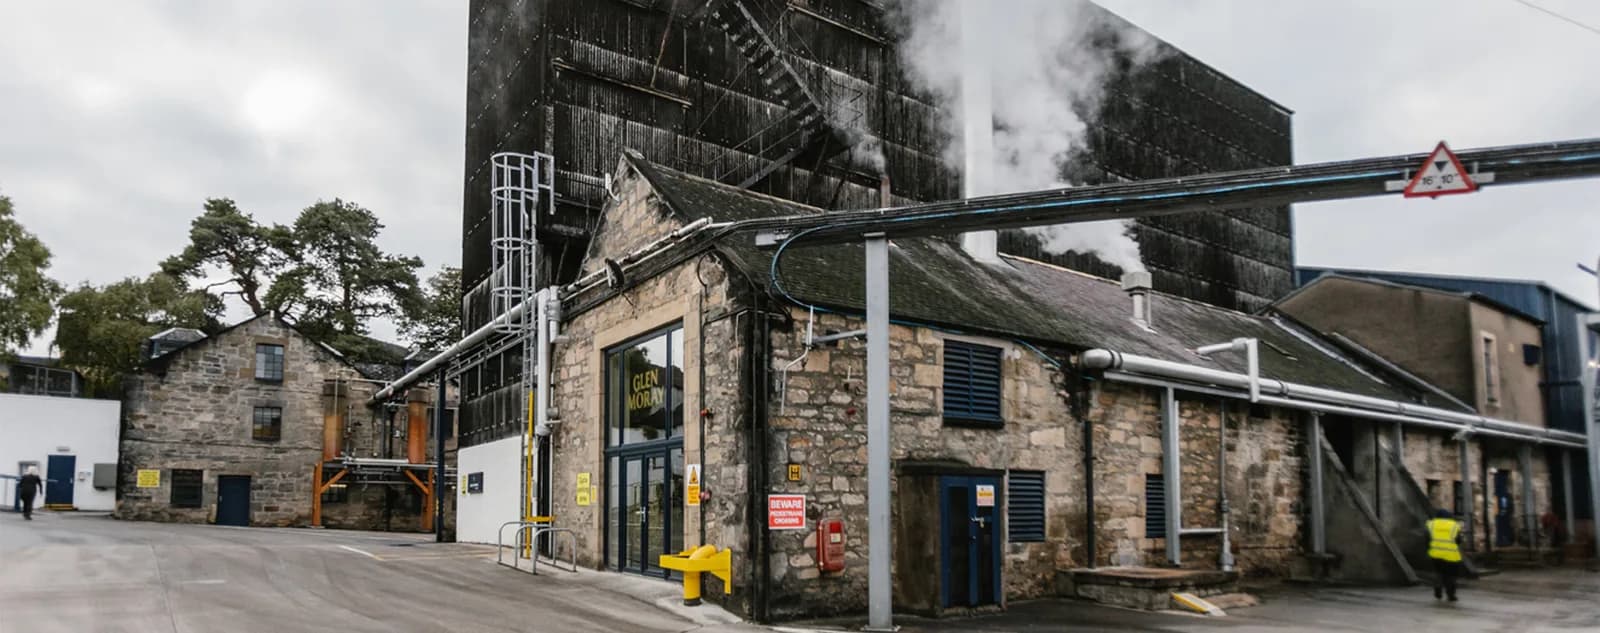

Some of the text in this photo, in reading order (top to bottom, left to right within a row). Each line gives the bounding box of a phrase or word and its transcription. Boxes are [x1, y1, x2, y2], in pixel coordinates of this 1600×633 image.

[633, 368, 658, 392] GLEN
[628, 385, 664, 409] MORAY
[770, 499, 803, 509] BEWARE
